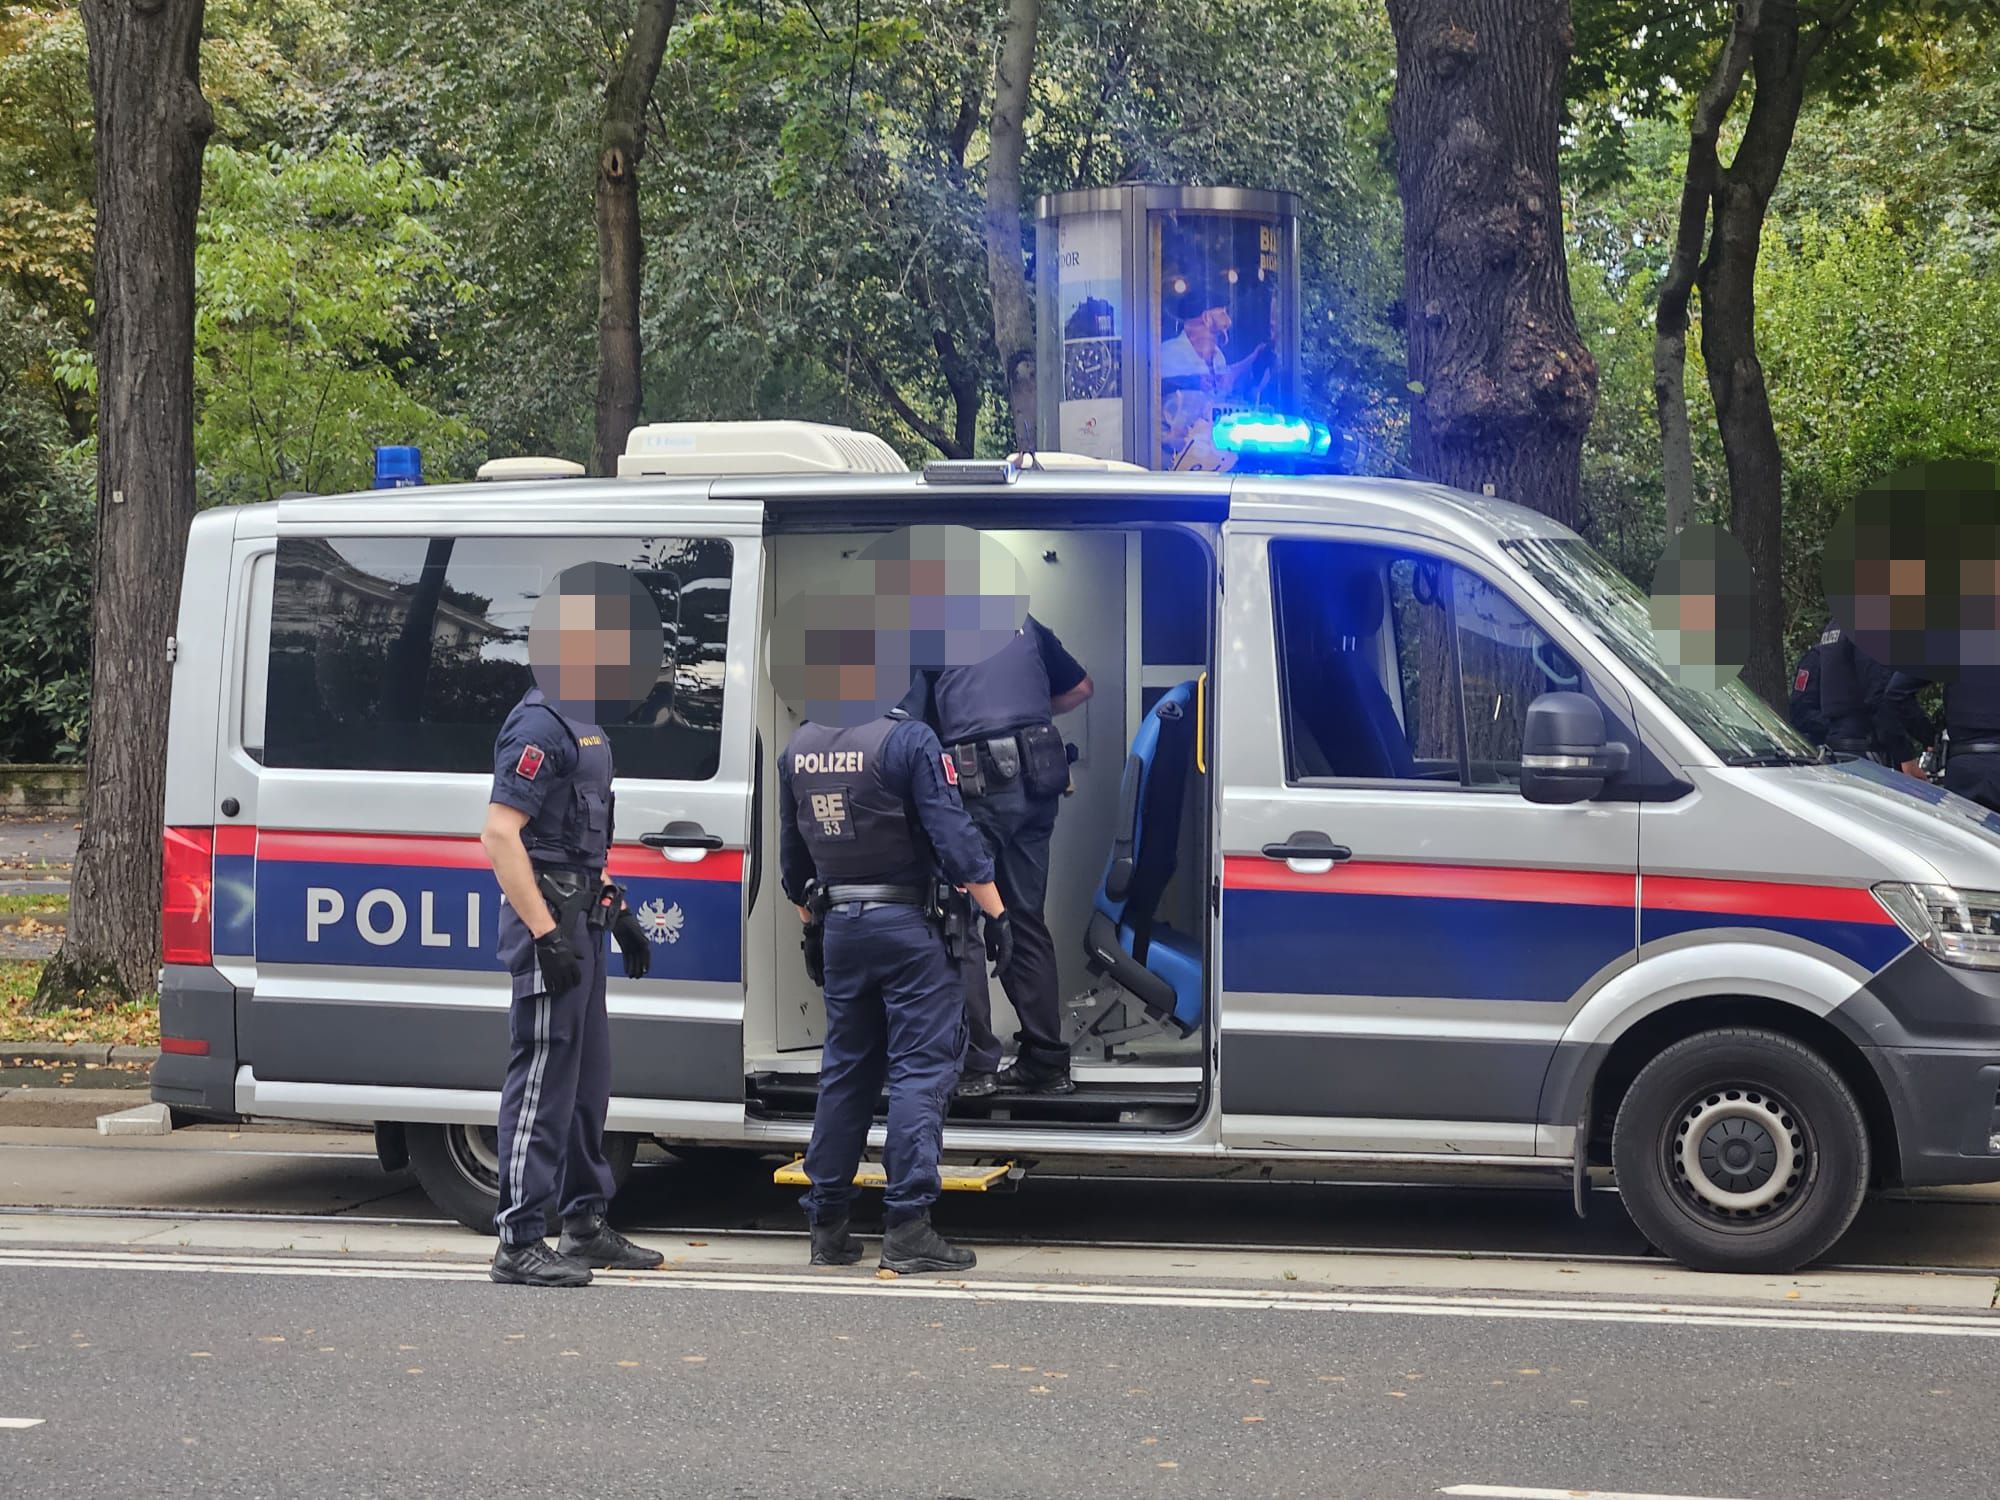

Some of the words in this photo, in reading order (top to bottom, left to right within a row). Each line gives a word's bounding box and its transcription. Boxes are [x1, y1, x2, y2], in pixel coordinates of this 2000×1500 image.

[794, 751, 864, 774] POLIZEI
[811, 793, 845, 818] BE
[823, 821, 841, 836] 53
